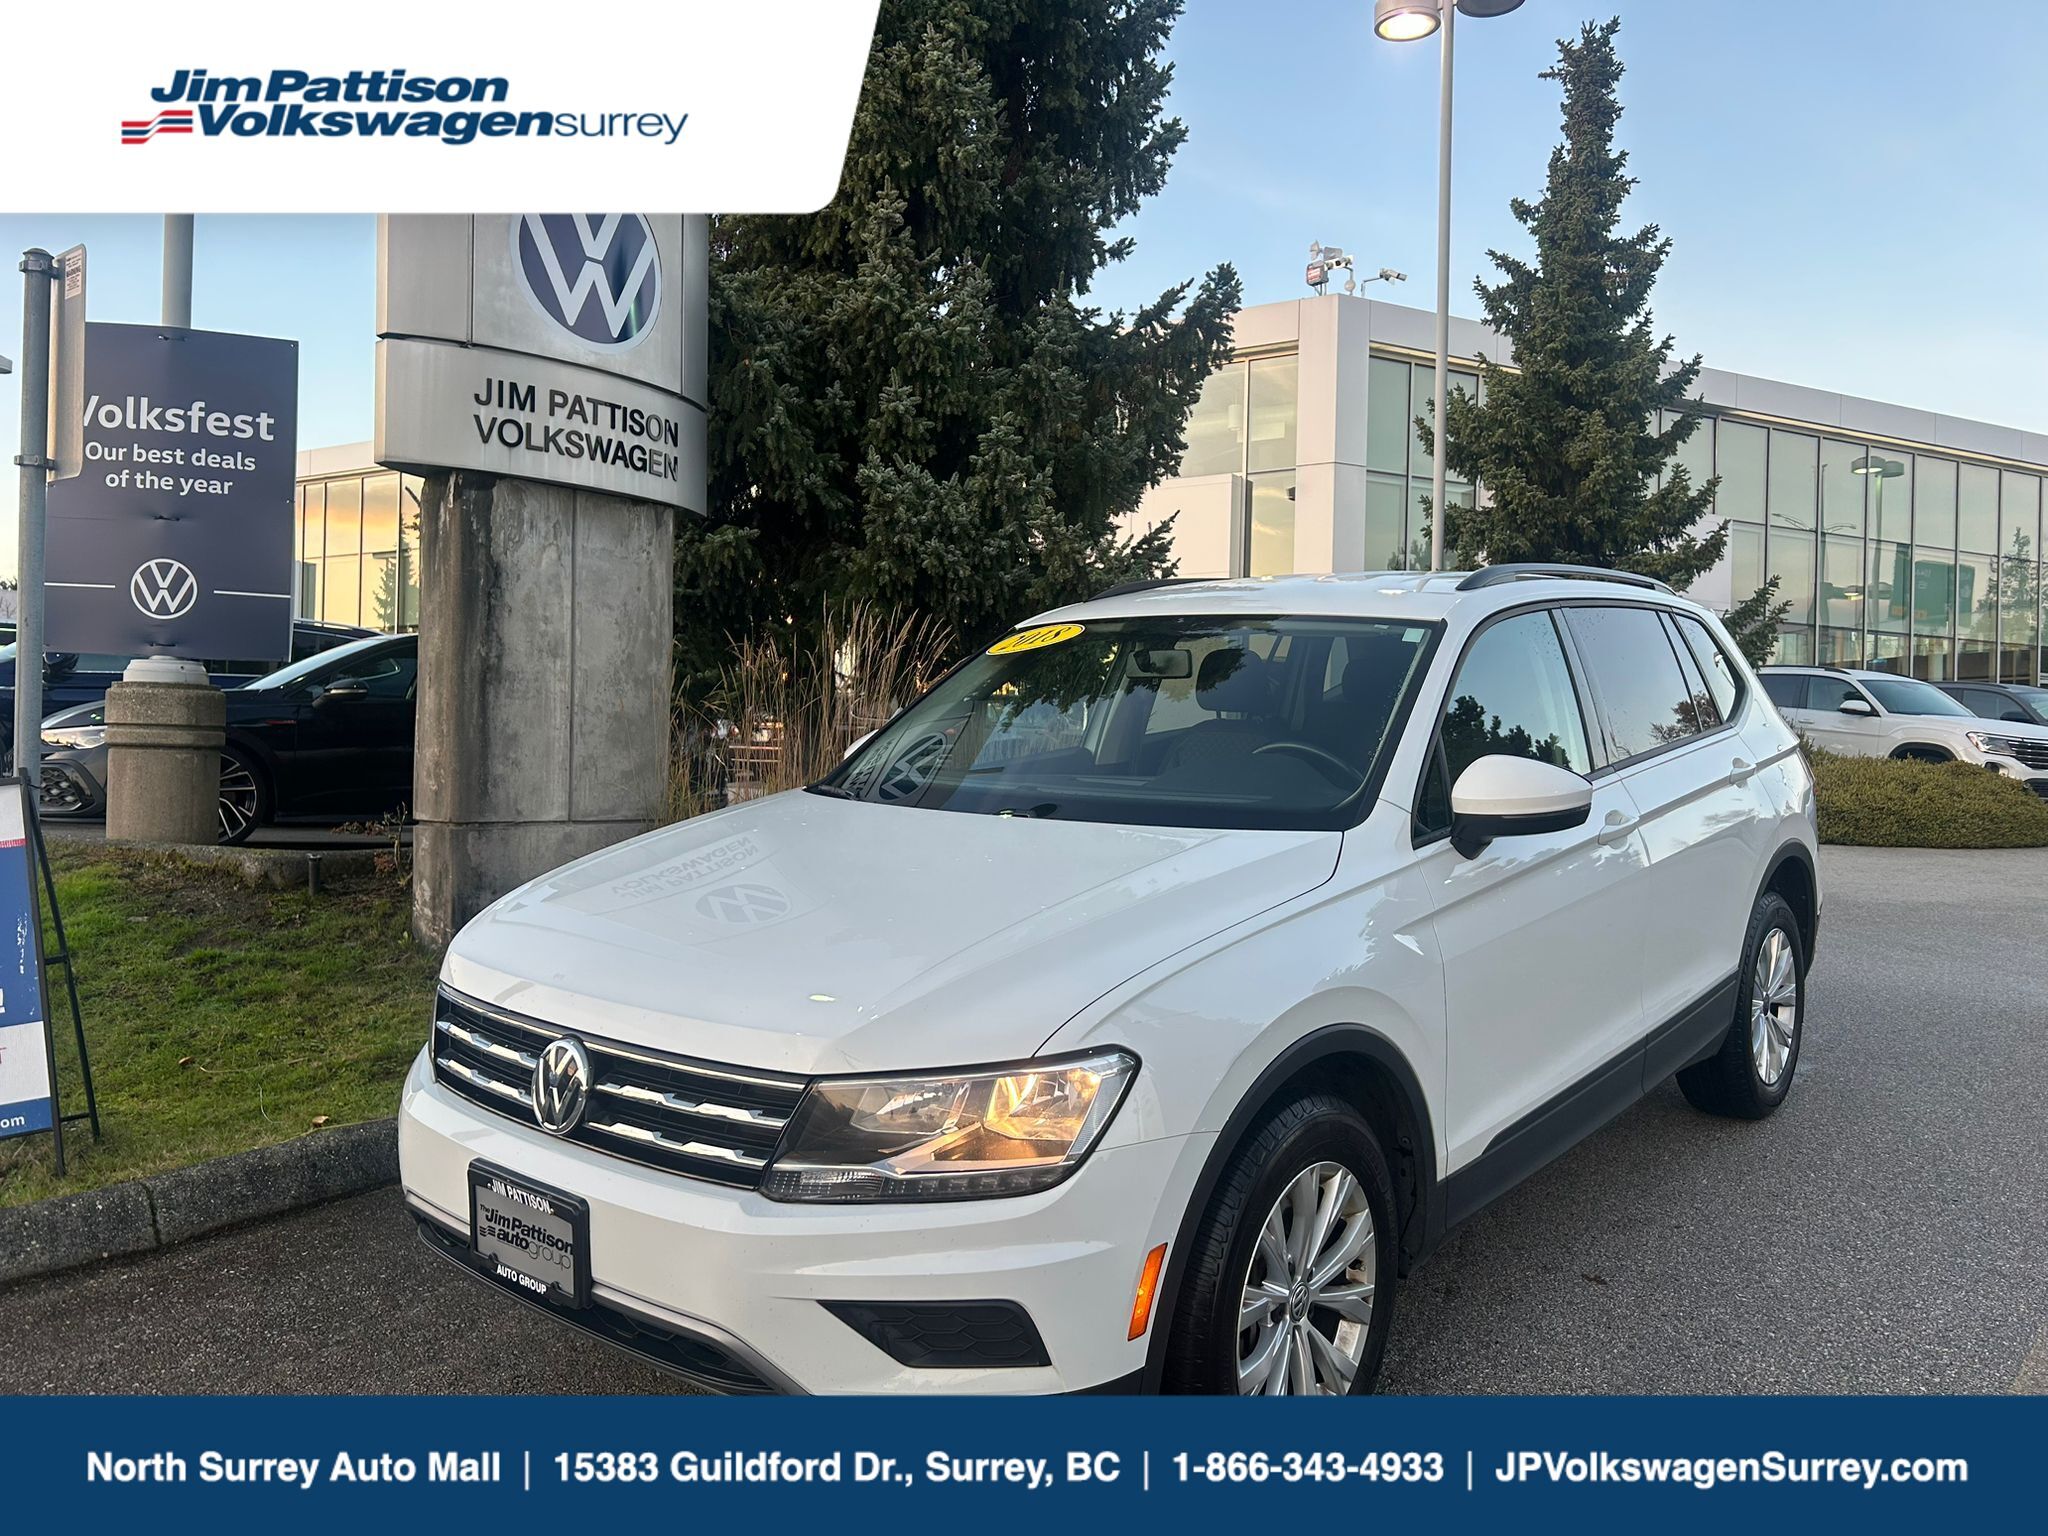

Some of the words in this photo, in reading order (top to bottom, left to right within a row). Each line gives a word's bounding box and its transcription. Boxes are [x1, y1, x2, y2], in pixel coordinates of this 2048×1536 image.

[474, 377, 536, 413] JIM
[549, 389, 679, 447] PATTISON
[85, 441, 127, 461] Our
[133, 443, 184, 465] best
[191, 448, 256, 471] deals
[473, 414, 679, 481] VOLKSWAGEN
[105, 469, 129, 488] of
[134, 470, 174, 490] the
[179, 477, 233, 496] year
[996, 627, 1071, 651] 2018
[491, 1179, 506, 1196] JIM
[507, 1185, 551, 1214] PATTISON
[496, 1264, 517, 1281] AUTO
[518, 1274, 547, 1295] GROUP
